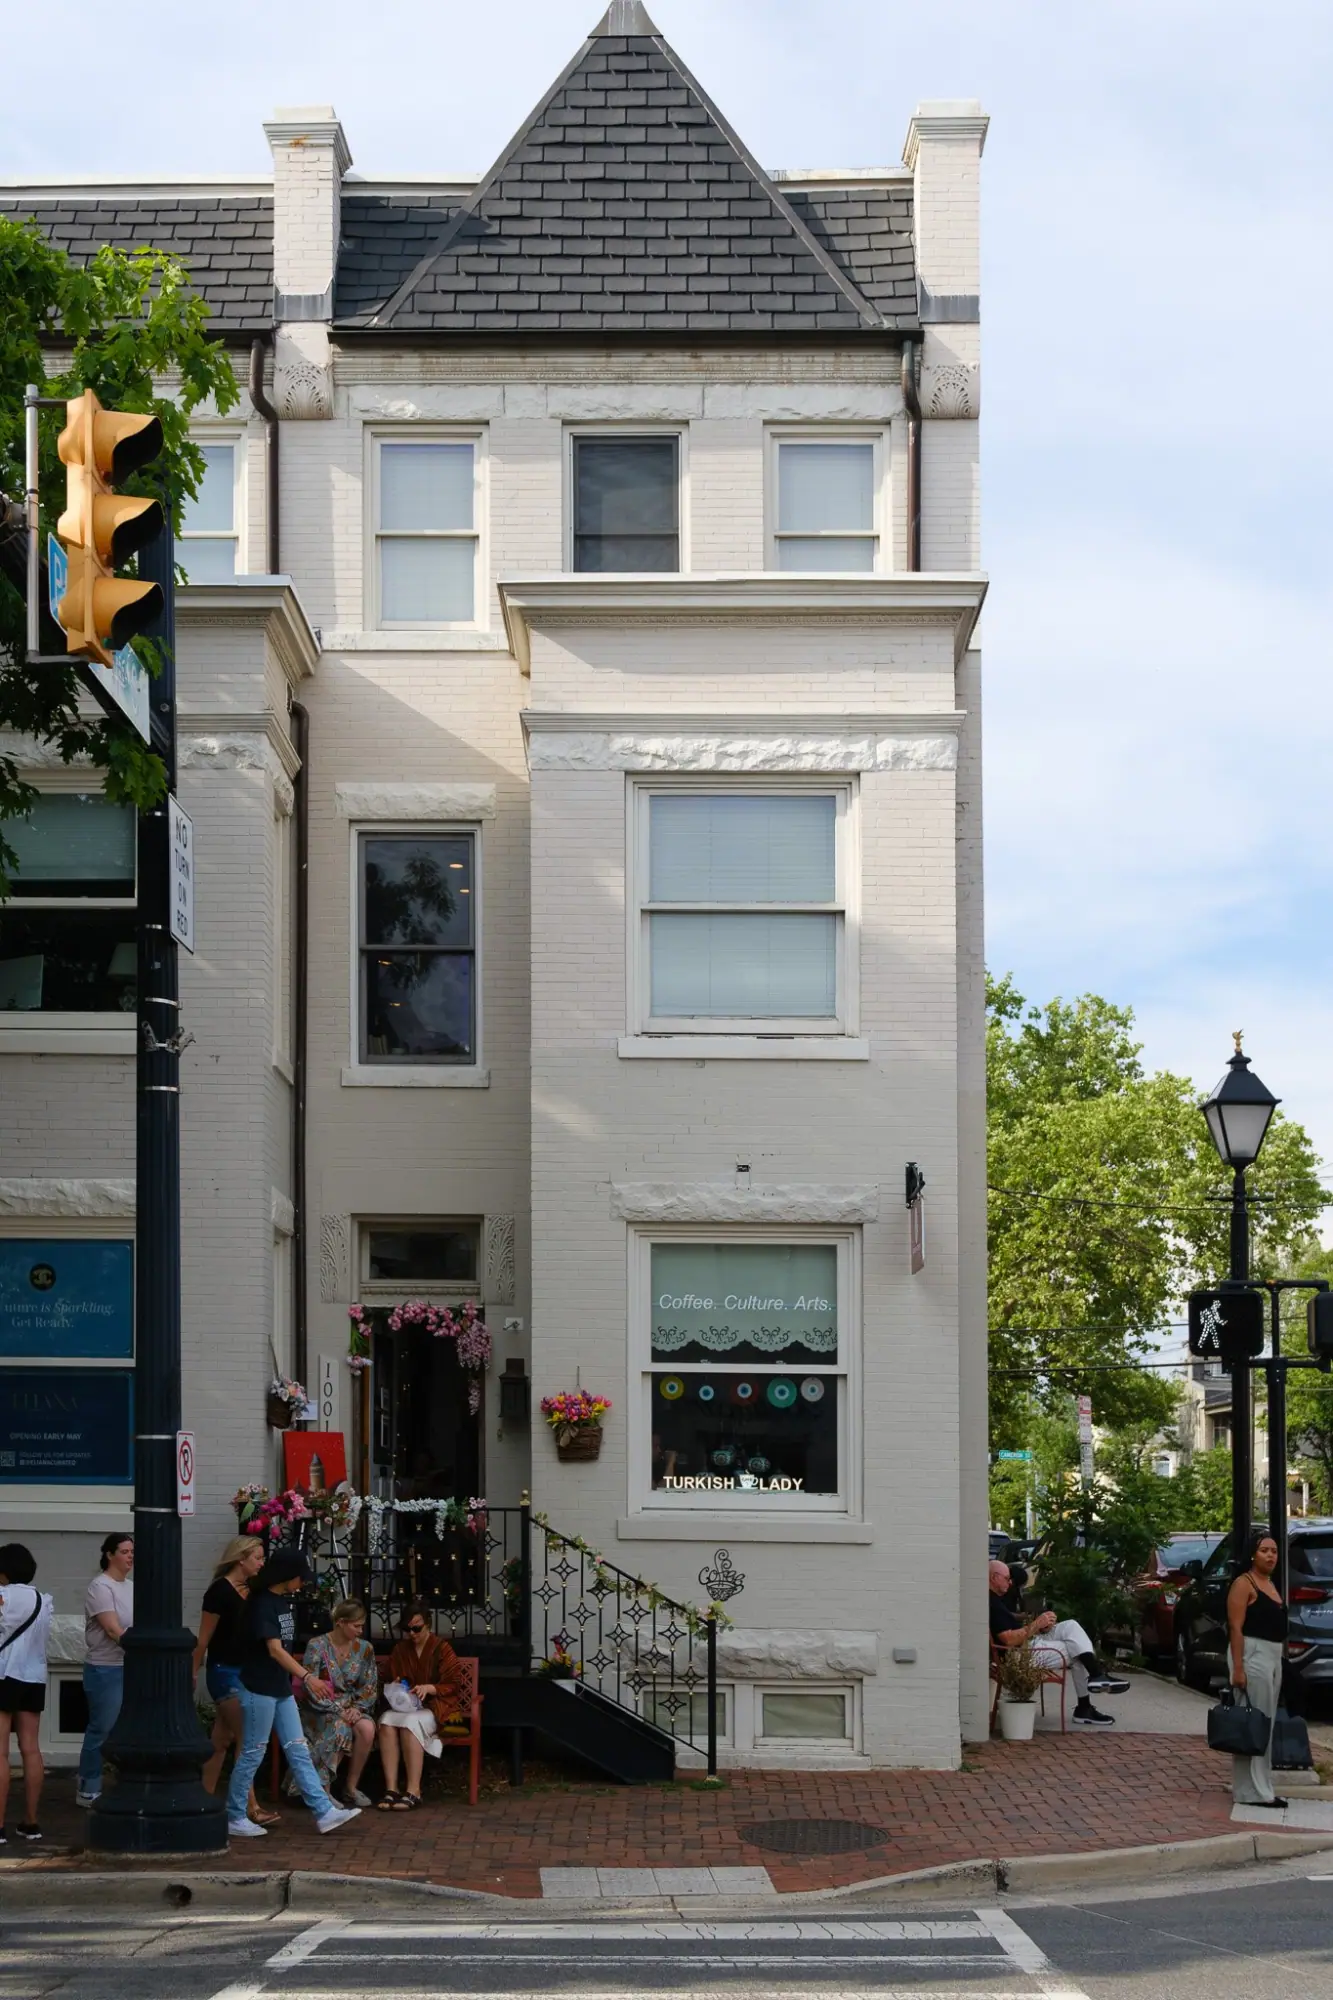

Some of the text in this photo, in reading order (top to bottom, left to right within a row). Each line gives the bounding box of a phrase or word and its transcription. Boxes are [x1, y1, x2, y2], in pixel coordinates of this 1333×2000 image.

[175, 815, 188, 849] NO
[174, 848, 190, 881] TURN
[178, 881, 187, 908] ON
[176, 909, 189, 937] RED
[659, 1294, 832, 1311] Coffee. Culture. Arts.
[11, 1316, 31, 1328] Get
[322, 1362, 333, 1432] 1001
[43, 1432, 64, 1440] EARLY
[66, 1432, 82, 1440] MAY
[663, 1476, 734, 1490] TURKISH
[759, 1477, 803, 1491] LADY
